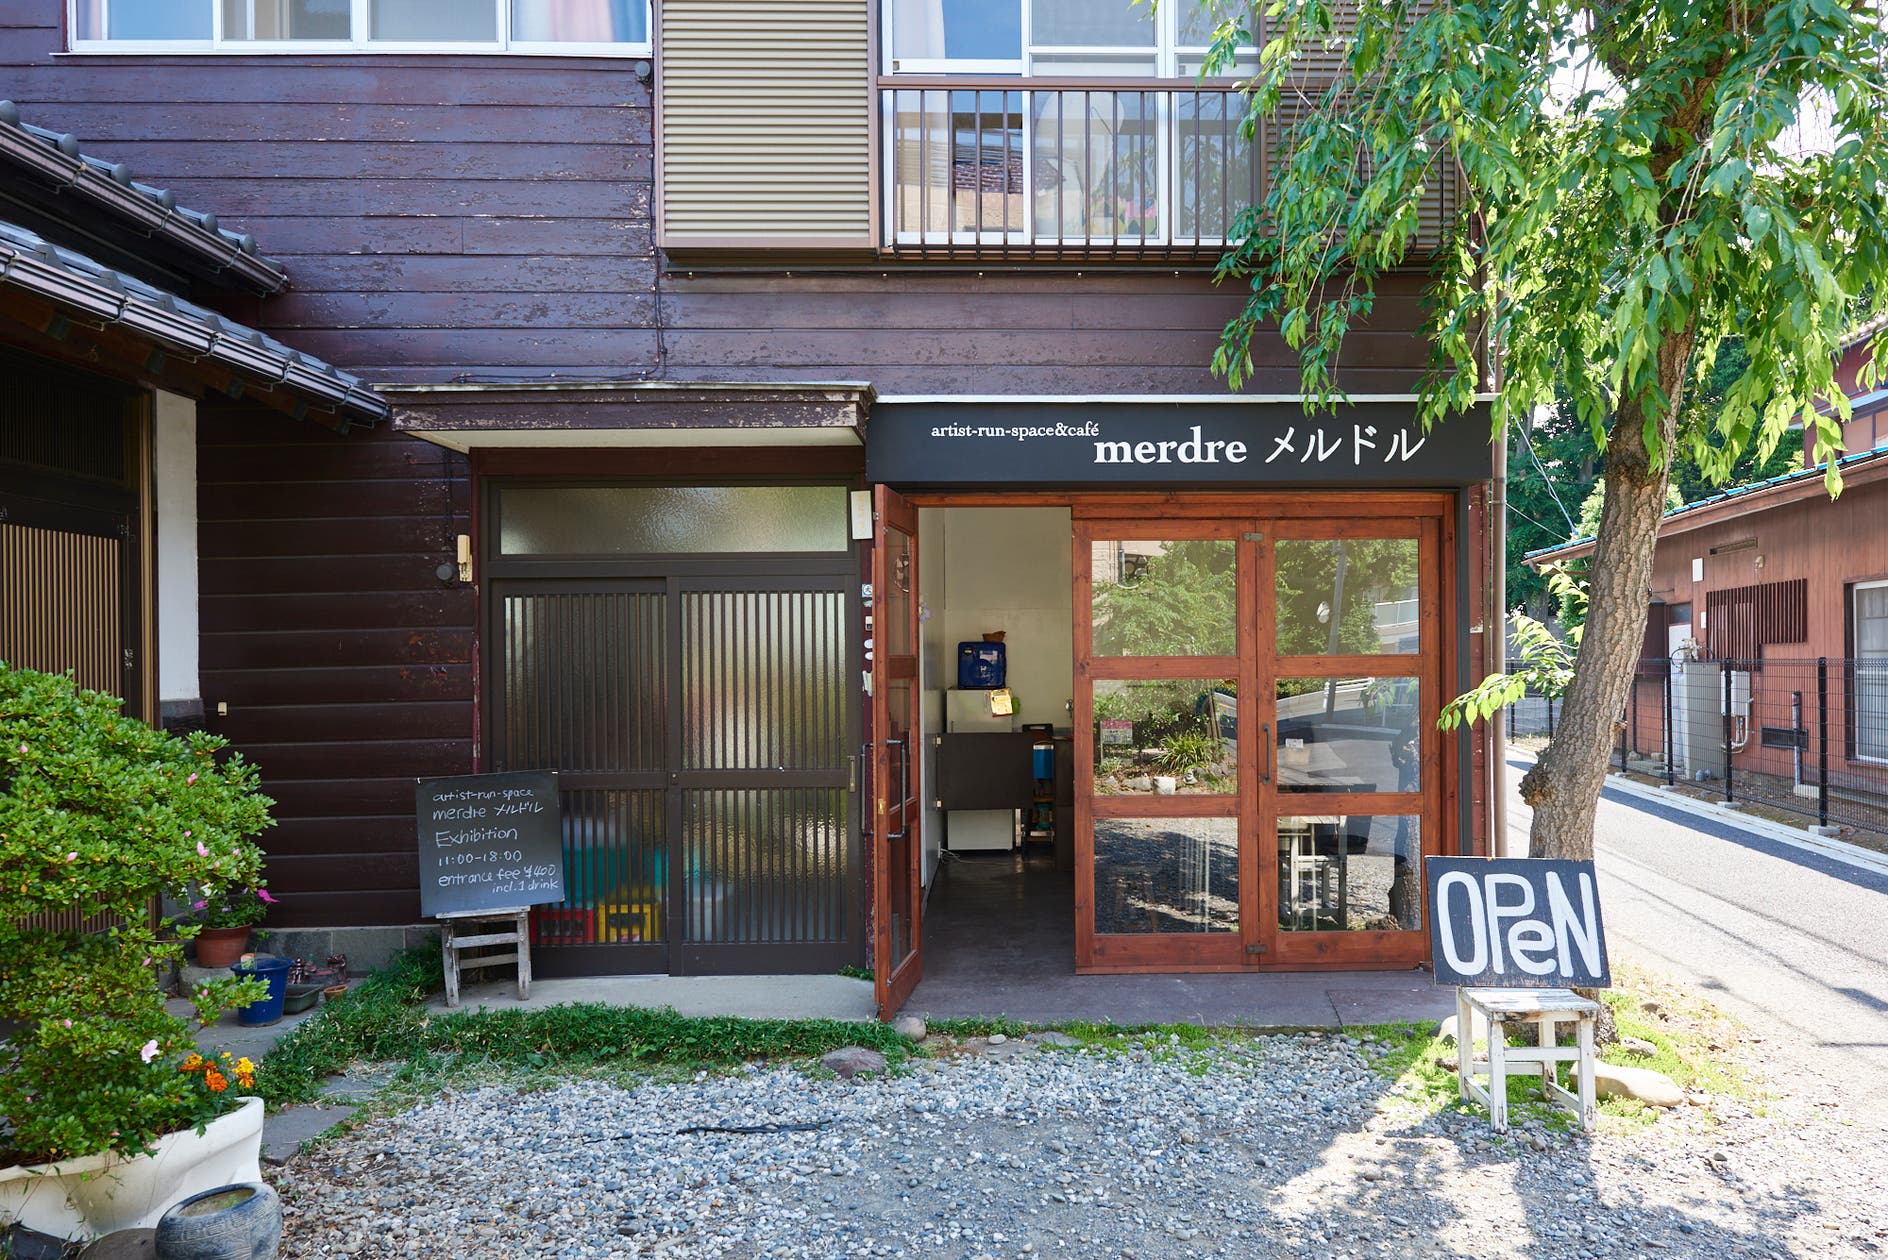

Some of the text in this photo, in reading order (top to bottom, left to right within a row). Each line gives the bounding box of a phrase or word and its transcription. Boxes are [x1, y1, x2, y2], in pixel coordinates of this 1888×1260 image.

[931, 420, 1100, 441] artist-run-space&café
[1093, 424, 1426, 465] merdre メルドル
[432, 789, 534, 801] artist-run-space
[432, 801, 544, 820] merdre メルドル
[435, 827, 518, 848] Exhibition
[438, 850, 522, 867] 11:00-18:00
[438, 864, 556, 887] entrance fee ¥400
[528, 878, 560, 891] drink
